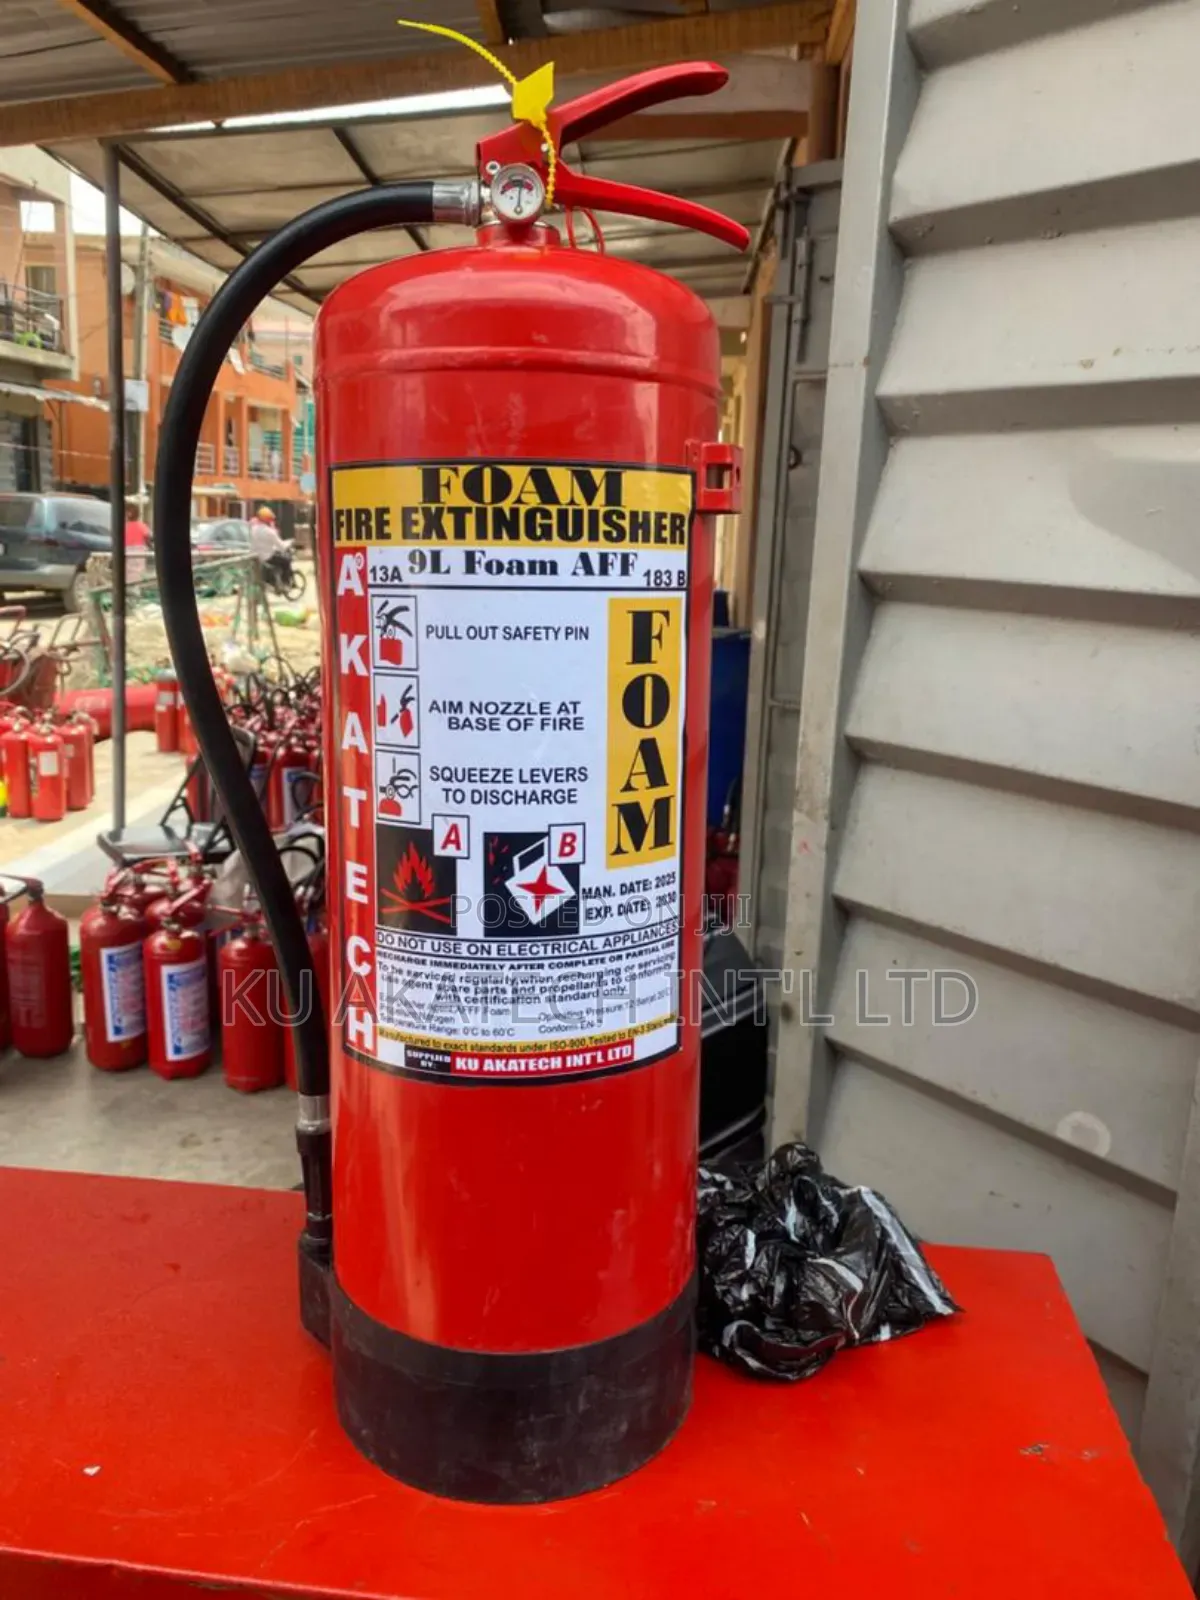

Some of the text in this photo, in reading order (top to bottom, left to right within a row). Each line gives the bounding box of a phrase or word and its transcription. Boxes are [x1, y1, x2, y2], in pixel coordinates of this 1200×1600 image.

[417, 466, 626, 508] FOAM
[335, 506, 686, 545] FIRE EXTINGUISHER
[408, 549, 638, 577] 9L Foam AFF
[370, 565, 403, 583] 13A
[643, 569, 673, 587] 183
[426, 625, 589, 641] PULL OUT SAFETY PIN
[428, 700, 581, 716] AIM NOZZLE AT
[447, 717, 584, 732] BASE OF FIRE
[609, 609, 676, 857] FOAM
[429, 766, 588, 785] SQUEEZE LEVERS
[442, 788, 578, 806] TO DISCHARGE
[441, 824, 463, 851] A
[558, 832, 577, 858] B
[581, 871, 676, 901] MAN. DATE: 2025
[585, 905, 614, 920] EXP.
[617, 899, 651, 916] DATE:
[376, 922, 678, 957] DO NOT USE ON ELECTRICAL APPLIANCES
[377, 950, 427, 966] RECHARGE
[430, 959, 505, 970] IMMEDIATELY
[508, 962, 544, 970] AFTER
[548, 957, 606, 970] COMPLETE
[626, 946, 659, 959] PARTIAL
[407, 969, 455, 982] serviced
[558, 966, 621, 982] recharging
[624, 963, 635, 973] or
[435, 993, 460, 1003] with
[464, 994, 541, 1005] certification
[545, 987, 599, 1004] standard
[437, 983, 470, 995] spare
[474, 985, 507, 996] parts
[511, 984, 535, 995] and
[611, 976, 622, 985] to
[406, 1050, 451, 1063] SUPPLIED
[470, 1042, 517, 1053] standards
[456, 1044, 632, 1072] KU AKATECH INT'L LTD
